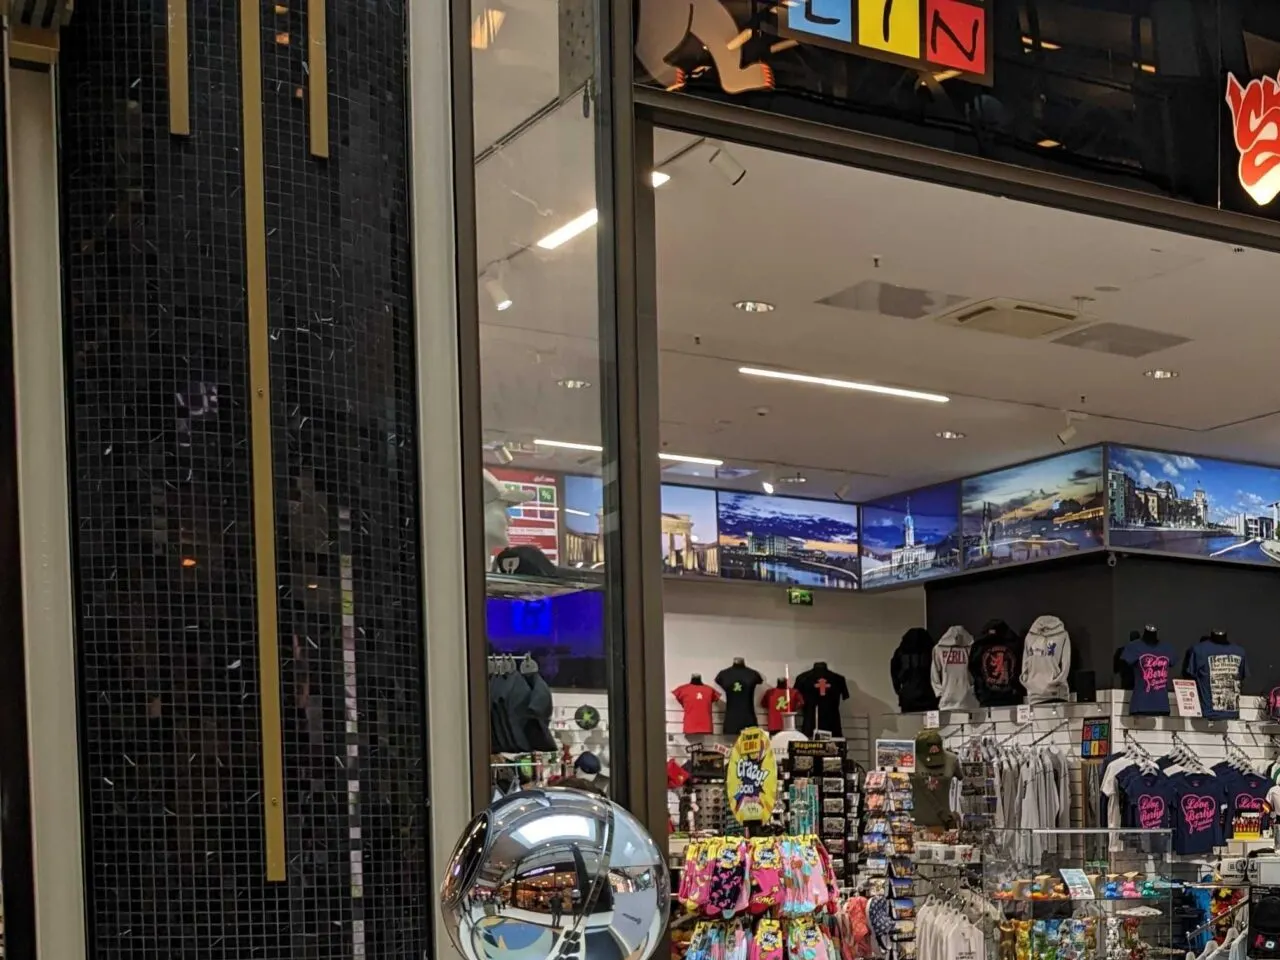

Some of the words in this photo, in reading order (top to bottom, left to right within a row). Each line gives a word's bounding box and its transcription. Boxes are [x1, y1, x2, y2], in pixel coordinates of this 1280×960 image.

[737, 758, 770, 787] Crazy!
[1185, 797, 1210, 810] Love
[1185, 807, 1215, 821] Berlin
